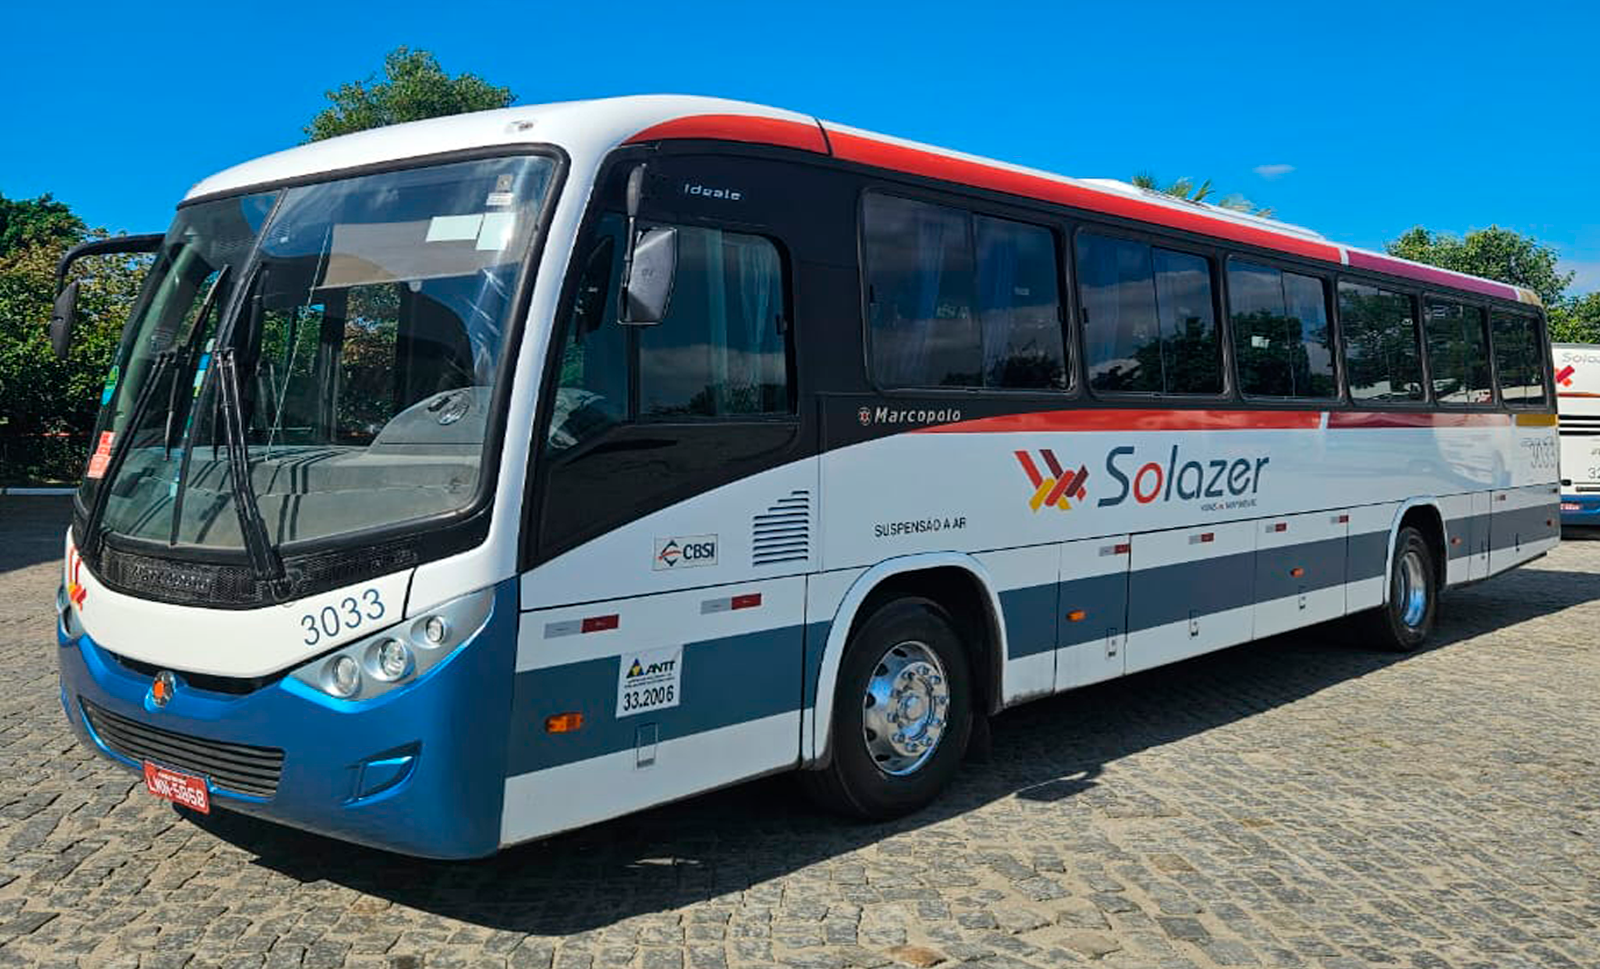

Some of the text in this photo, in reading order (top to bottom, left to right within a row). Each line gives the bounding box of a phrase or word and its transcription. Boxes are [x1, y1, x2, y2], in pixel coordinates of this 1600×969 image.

[684, 183, 742, 201] Ideale
[875, 407, 961, 423] Marcopolo
[1098, 444, 1270, 508] Solazer
[943, 517, 951, 530] A
[683, 542, 715, 560] CBSI
[301, 588, 385, 646] 3033
[645, 660, 676, 676] ANTT
[623, 684, 675, 711] 33.2006
